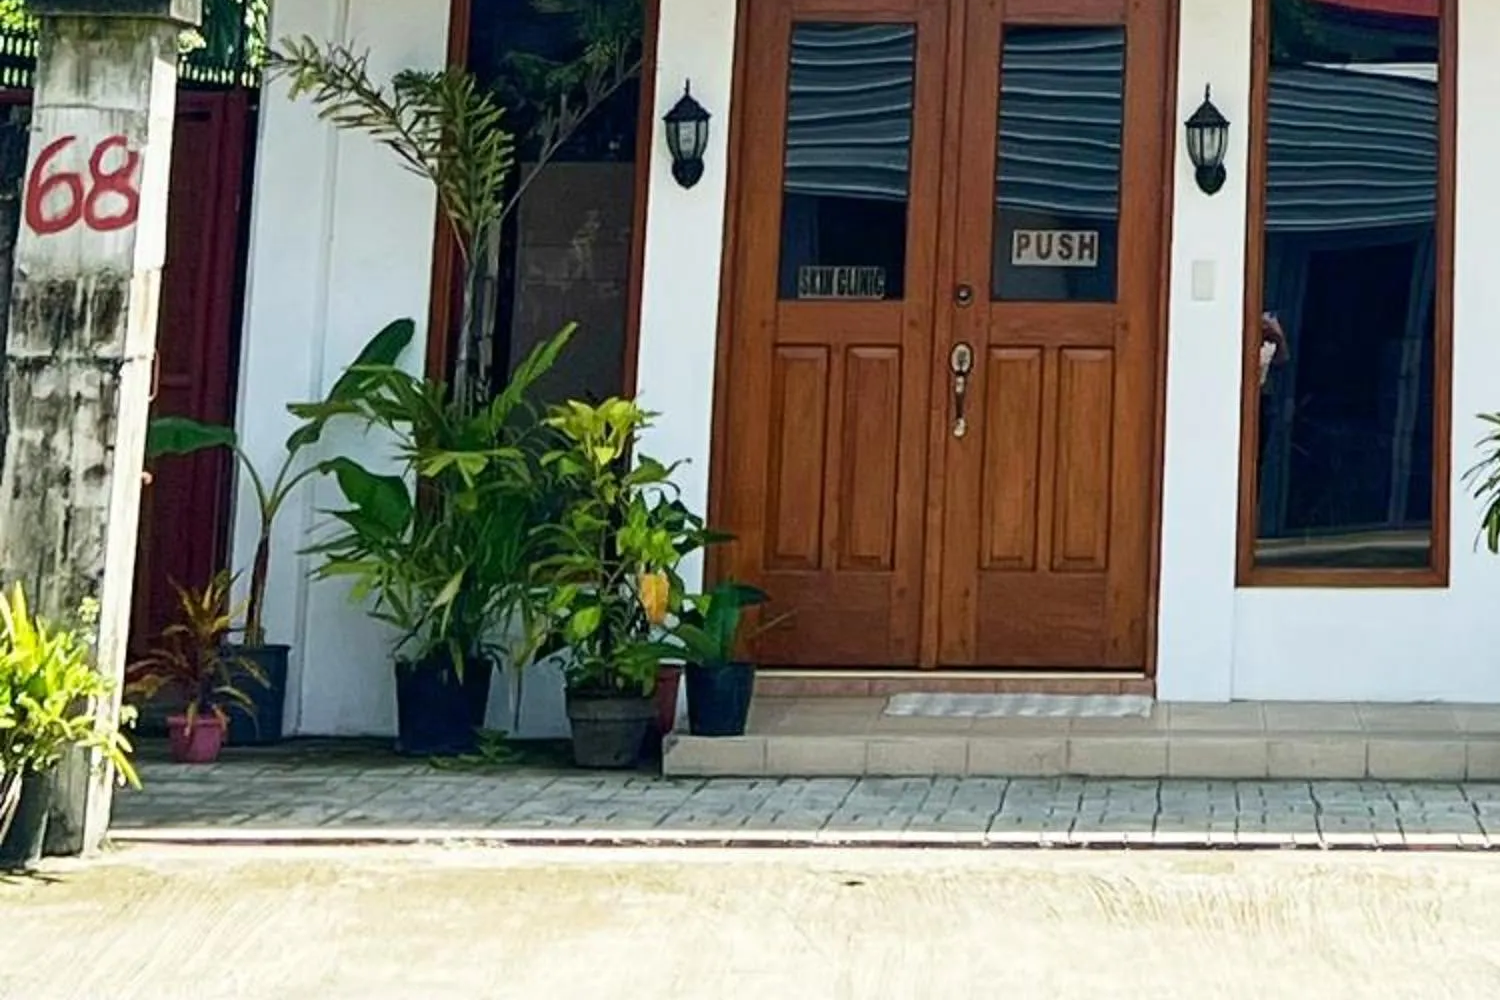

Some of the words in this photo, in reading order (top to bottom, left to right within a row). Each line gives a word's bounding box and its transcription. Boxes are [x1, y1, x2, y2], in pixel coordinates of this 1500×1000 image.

[25, 135, 140, 236] 68
[1016, 233, 1096, 261] PUSH
[800, 267, 833, 296] SKIN
[837, 267, 884, 297] CLINIC
